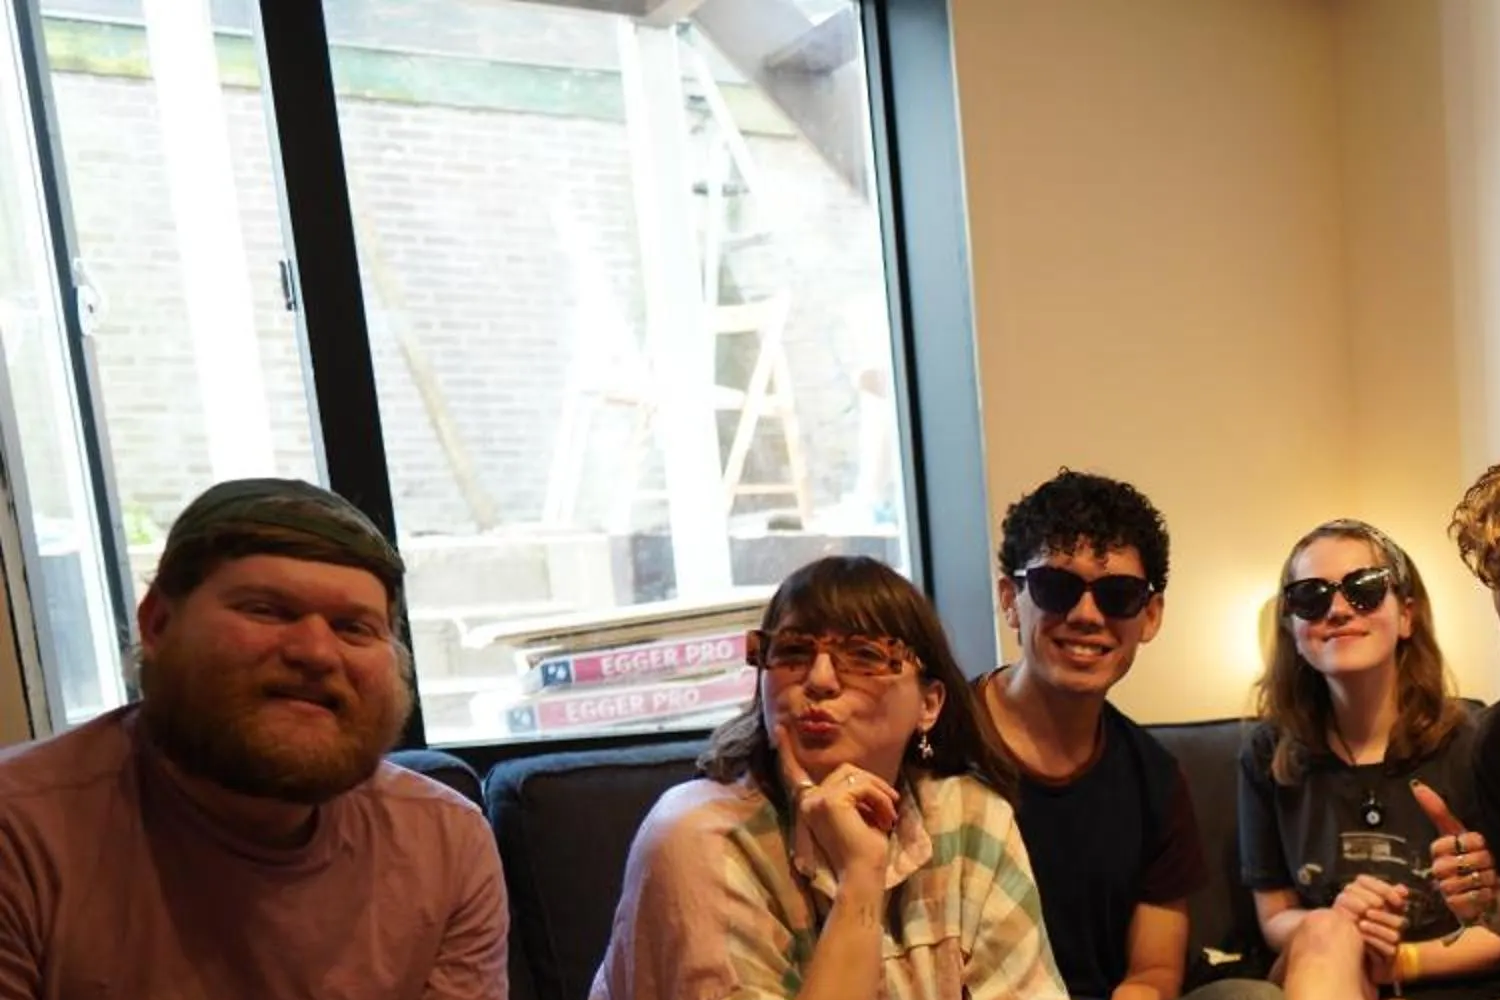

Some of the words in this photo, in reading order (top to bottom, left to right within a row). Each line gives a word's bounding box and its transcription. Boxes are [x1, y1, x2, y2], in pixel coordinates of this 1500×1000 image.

[601, 646, 678, 674] EGGER
[685, 640, 734, 662] PRO
[565, 695, 644, 720] EGGER
[653, 689, 700, 710] PRO
